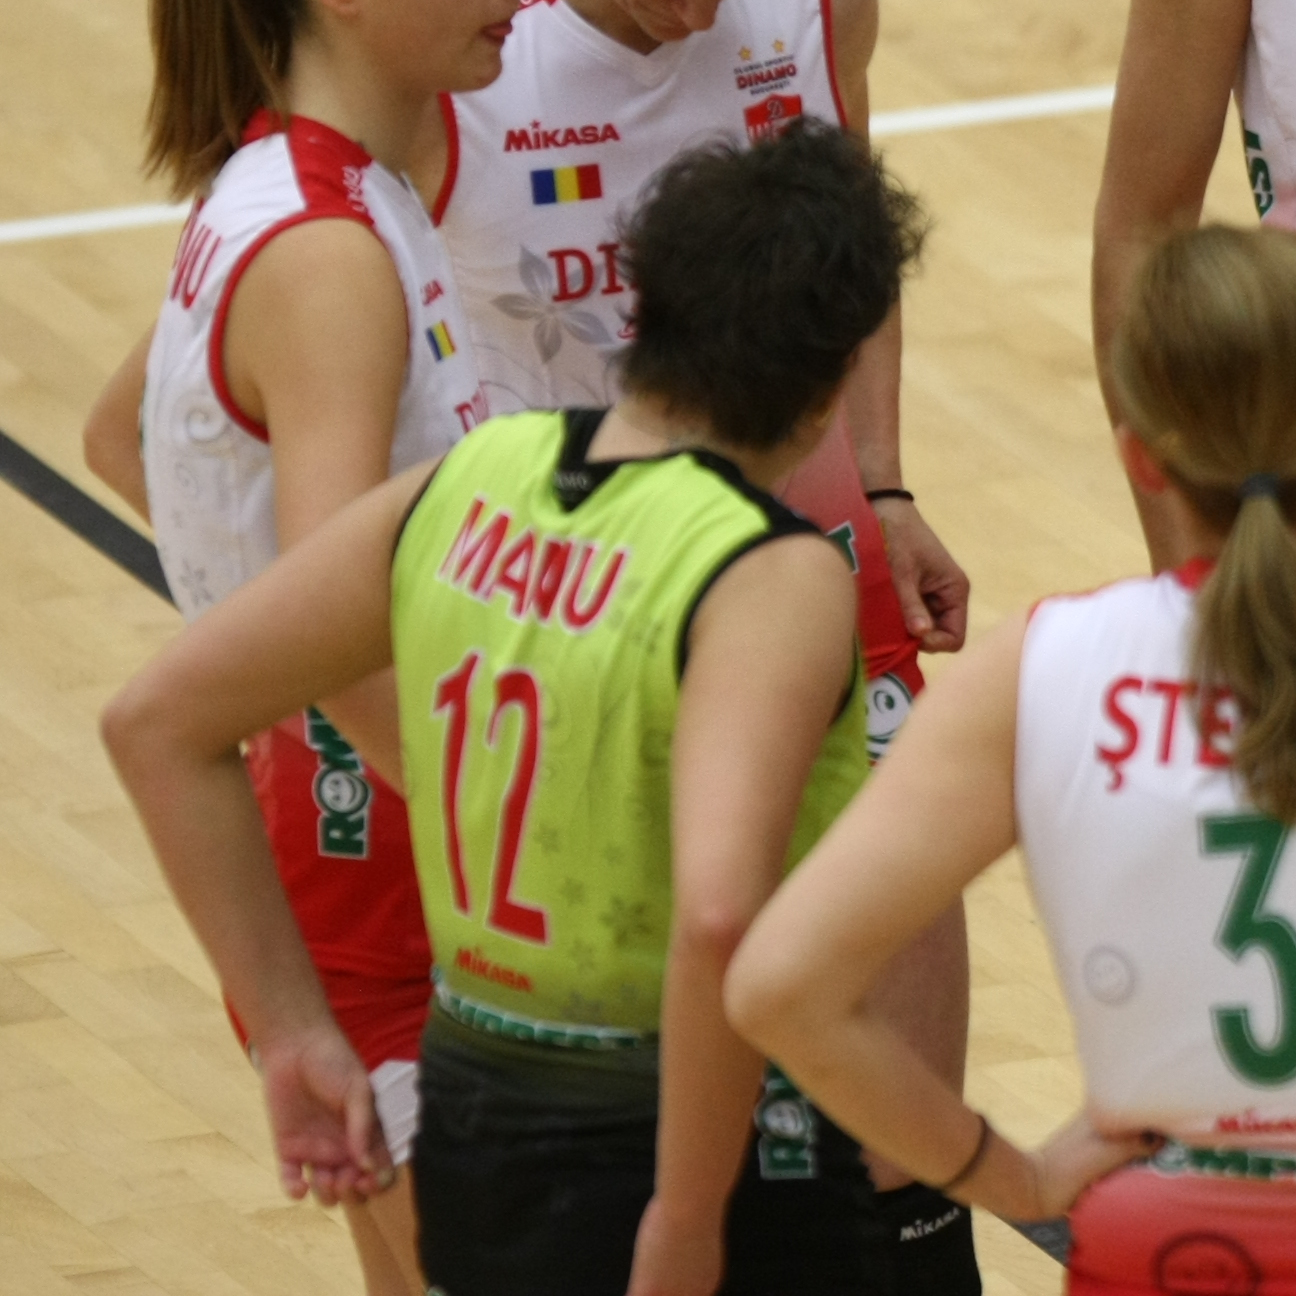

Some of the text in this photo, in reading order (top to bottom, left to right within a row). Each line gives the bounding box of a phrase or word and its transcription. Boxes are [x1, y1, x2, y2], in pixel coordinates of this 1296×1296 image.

[736, 63, 797, 90] DINAMO
[438, 496, 626, 631] MANU
[434, 648, 551, 946] 12
